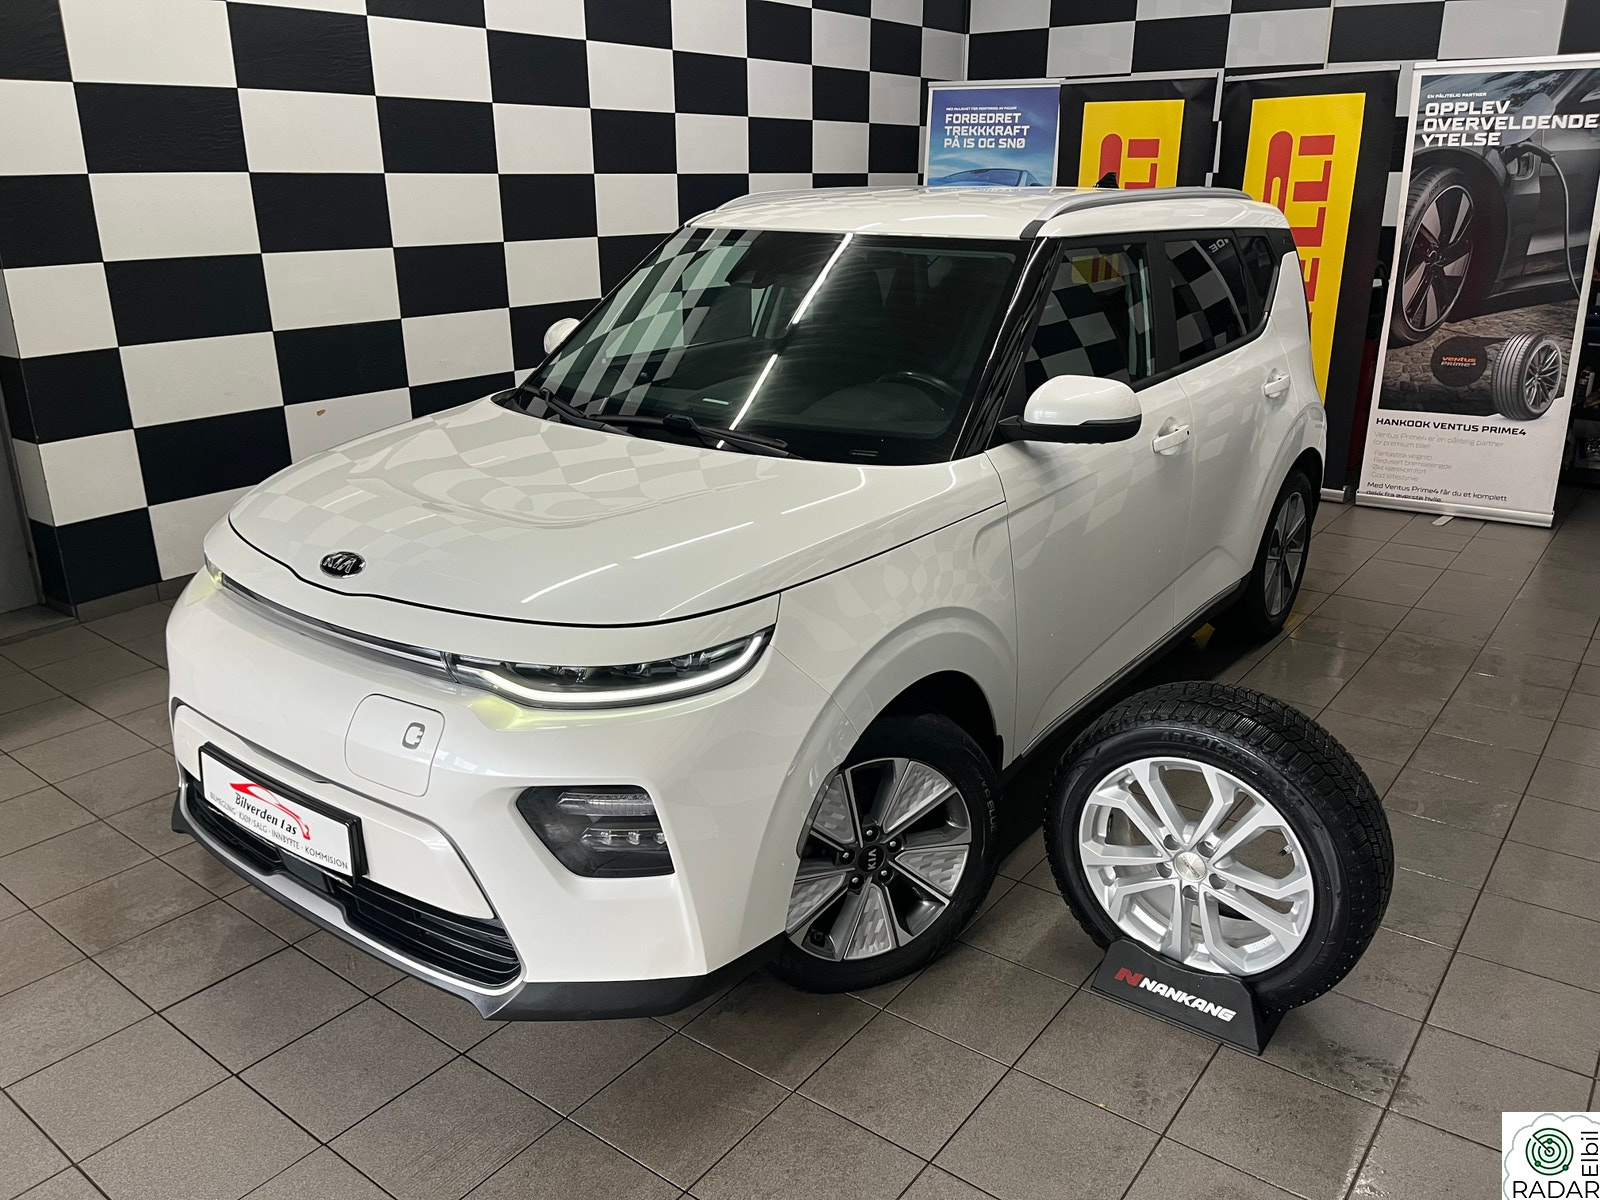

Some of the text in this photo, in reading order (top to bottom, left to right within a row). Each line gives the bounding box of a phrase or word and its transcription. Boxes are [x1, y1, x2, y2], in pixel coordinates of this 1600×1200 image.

[1425, 100, 1511, 116] OPPLEV
[945, 113, 1022, 124] FORBEDRET
[1424, 114, 1600, 132] OVERVELDENDE
[944, 126, 1030, 136] TREKKKRAFT
[1422, 132, 1501, 147] YTELSE
[944, 135, 1026, 148] PÅ IS OG SNØ
[1376, 418, 1527, 436] HANKOOK VENTUS PRIME4
[1385, 483, 1410, 491] Ventus
[1412, 486, 1439, 494] Prime4
[235, 792, 278, 825] Bilverden
[286, 824, 297, 835] as
[305, 846, 348, 869] KOMMISION
[868, 849, 877, 870] KIA
[1139, 977, 1237, 1022] NANKANG
